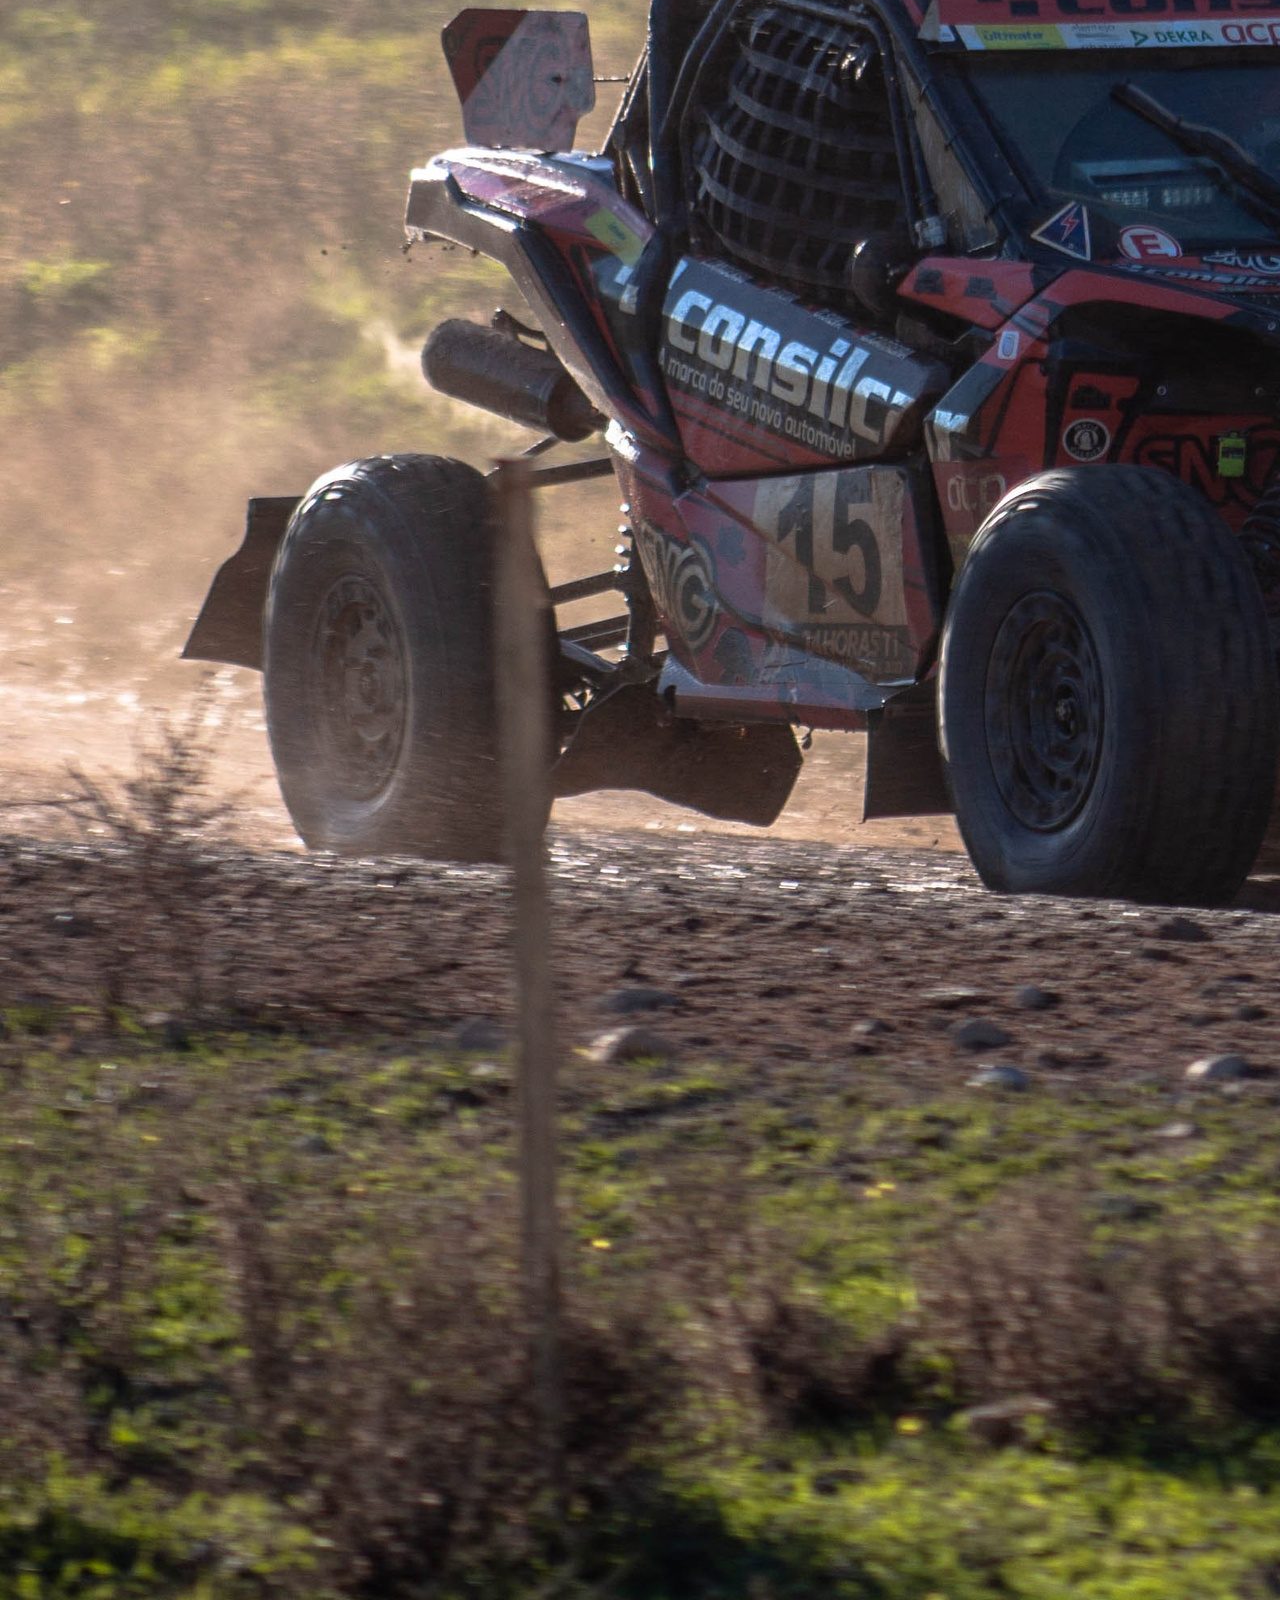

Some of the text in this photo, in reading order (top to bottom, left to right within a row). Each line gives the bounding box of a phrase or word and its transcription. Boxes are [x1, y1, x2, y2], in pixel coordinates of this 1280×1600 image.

[1154, 30, 1214, 43] DEKRA
[667, 358, 707, 390] marca
[708, 371, 725, 400] do
[726, 386, 749, 413] seu
[750, 399, 782, 429] novo
[784, 415, 857, 458] automóvel
[777, 472, 882, 617] 15
